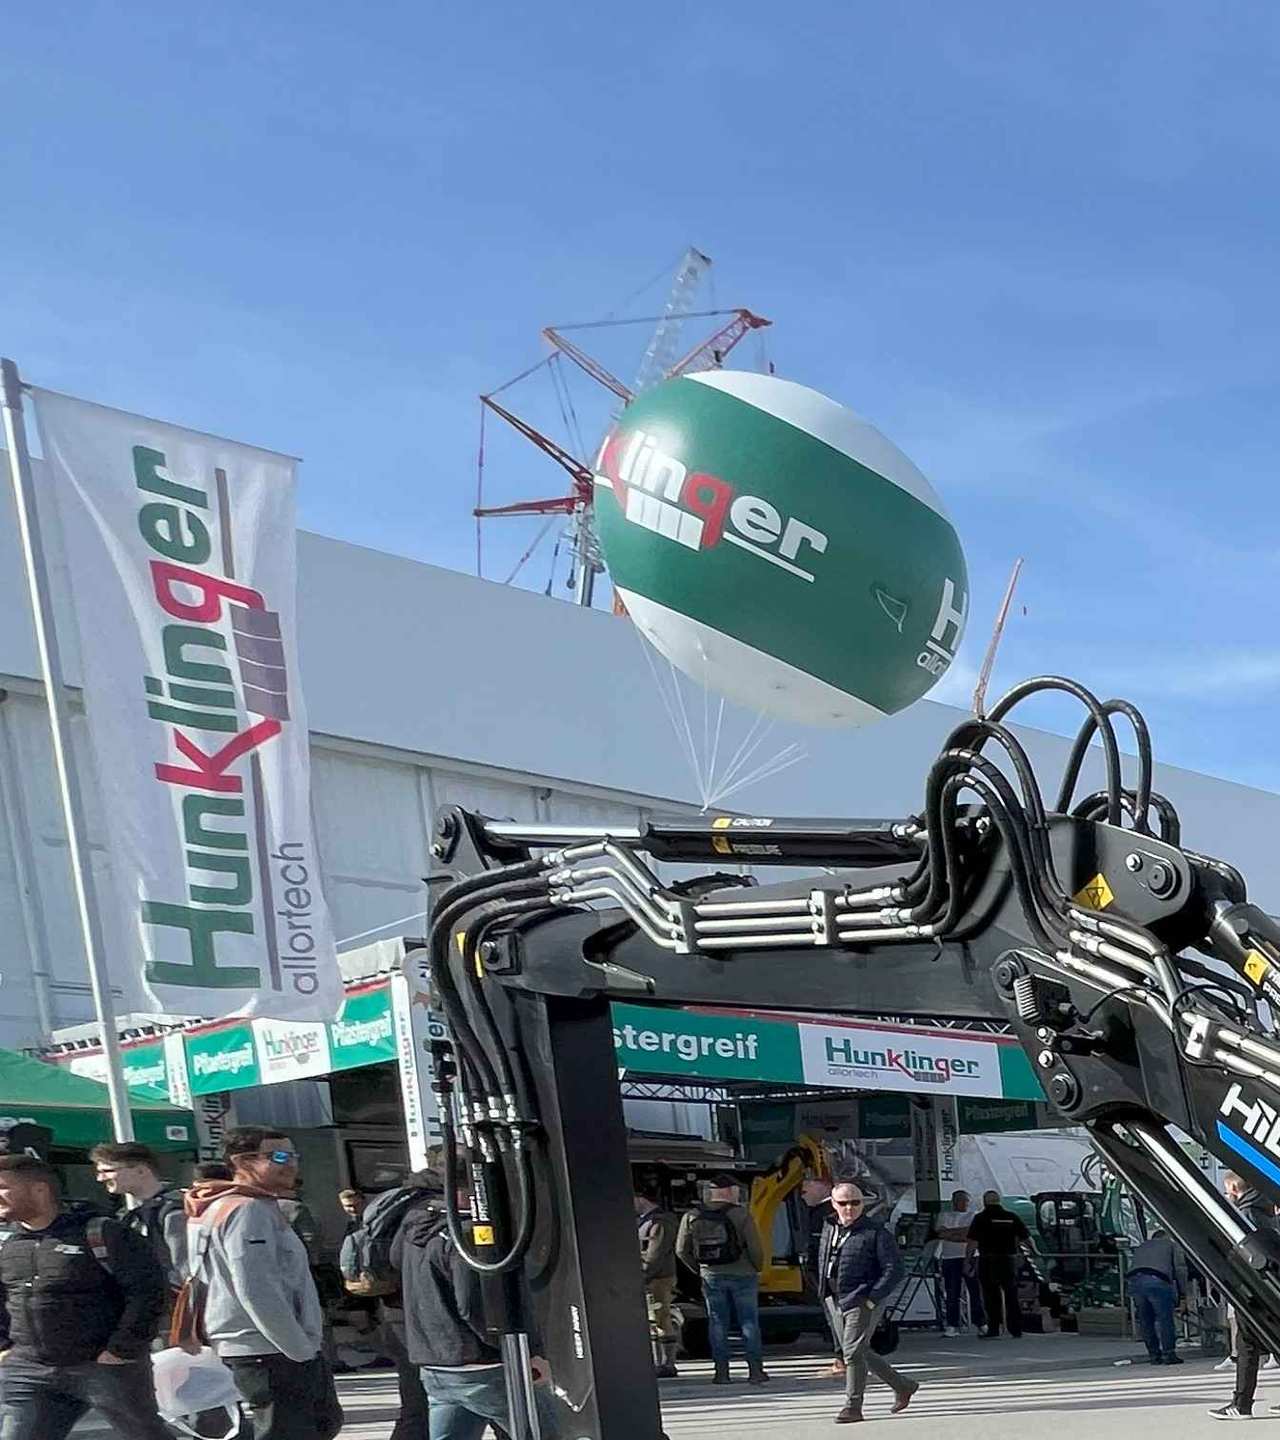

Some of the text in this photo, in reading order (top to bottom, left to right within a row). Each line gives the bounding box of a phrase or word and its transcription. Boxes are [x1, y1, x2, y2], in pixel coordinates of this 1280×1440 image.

[133, 446, 283, 991] Hunklinger
[276, 841, 320, 997] allortech
[825, 1036, 980, 1083] Hunklinger
